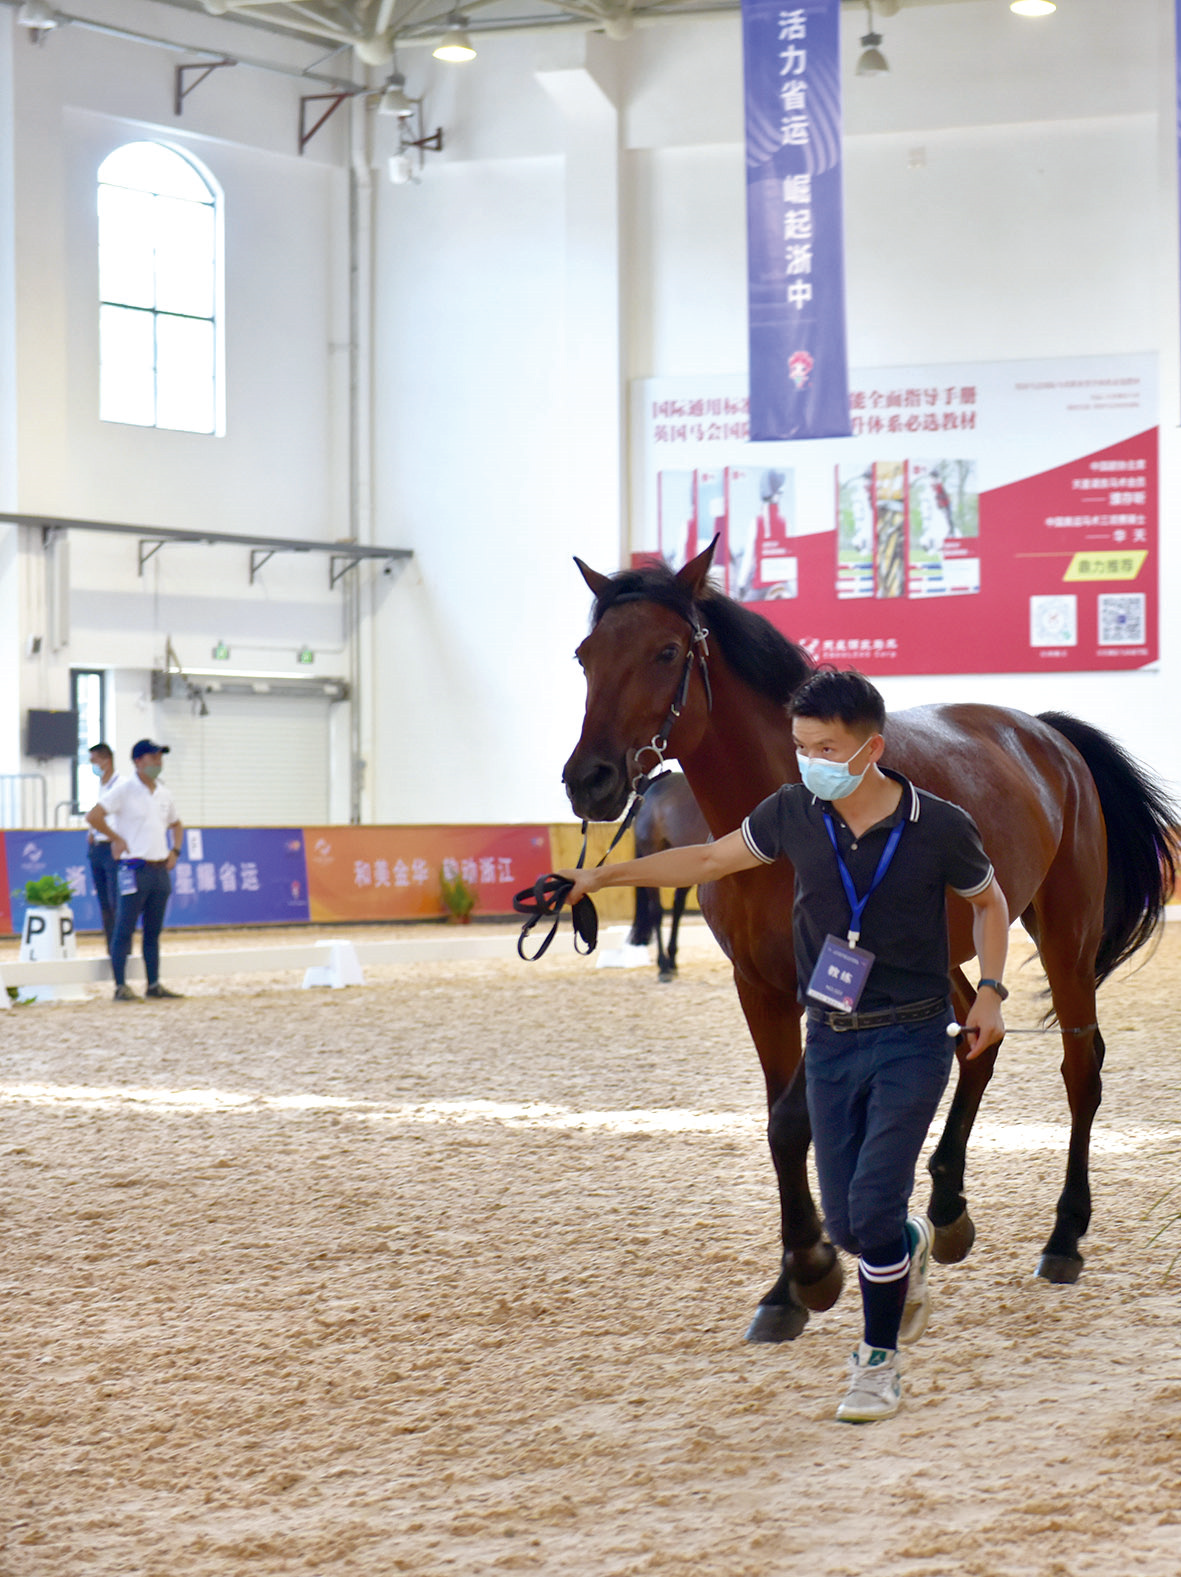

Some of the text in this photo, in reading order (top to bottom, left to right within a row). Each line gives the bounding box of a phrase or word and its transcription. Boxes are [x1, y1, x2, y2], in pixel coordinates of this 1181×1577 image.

[778, 9, 813, 310] 活力省运 崛起浙中
[353, 857, 430, 888] 和美金华
[26, 916, 46, 944] P
[60, 917, 74, 946] P
